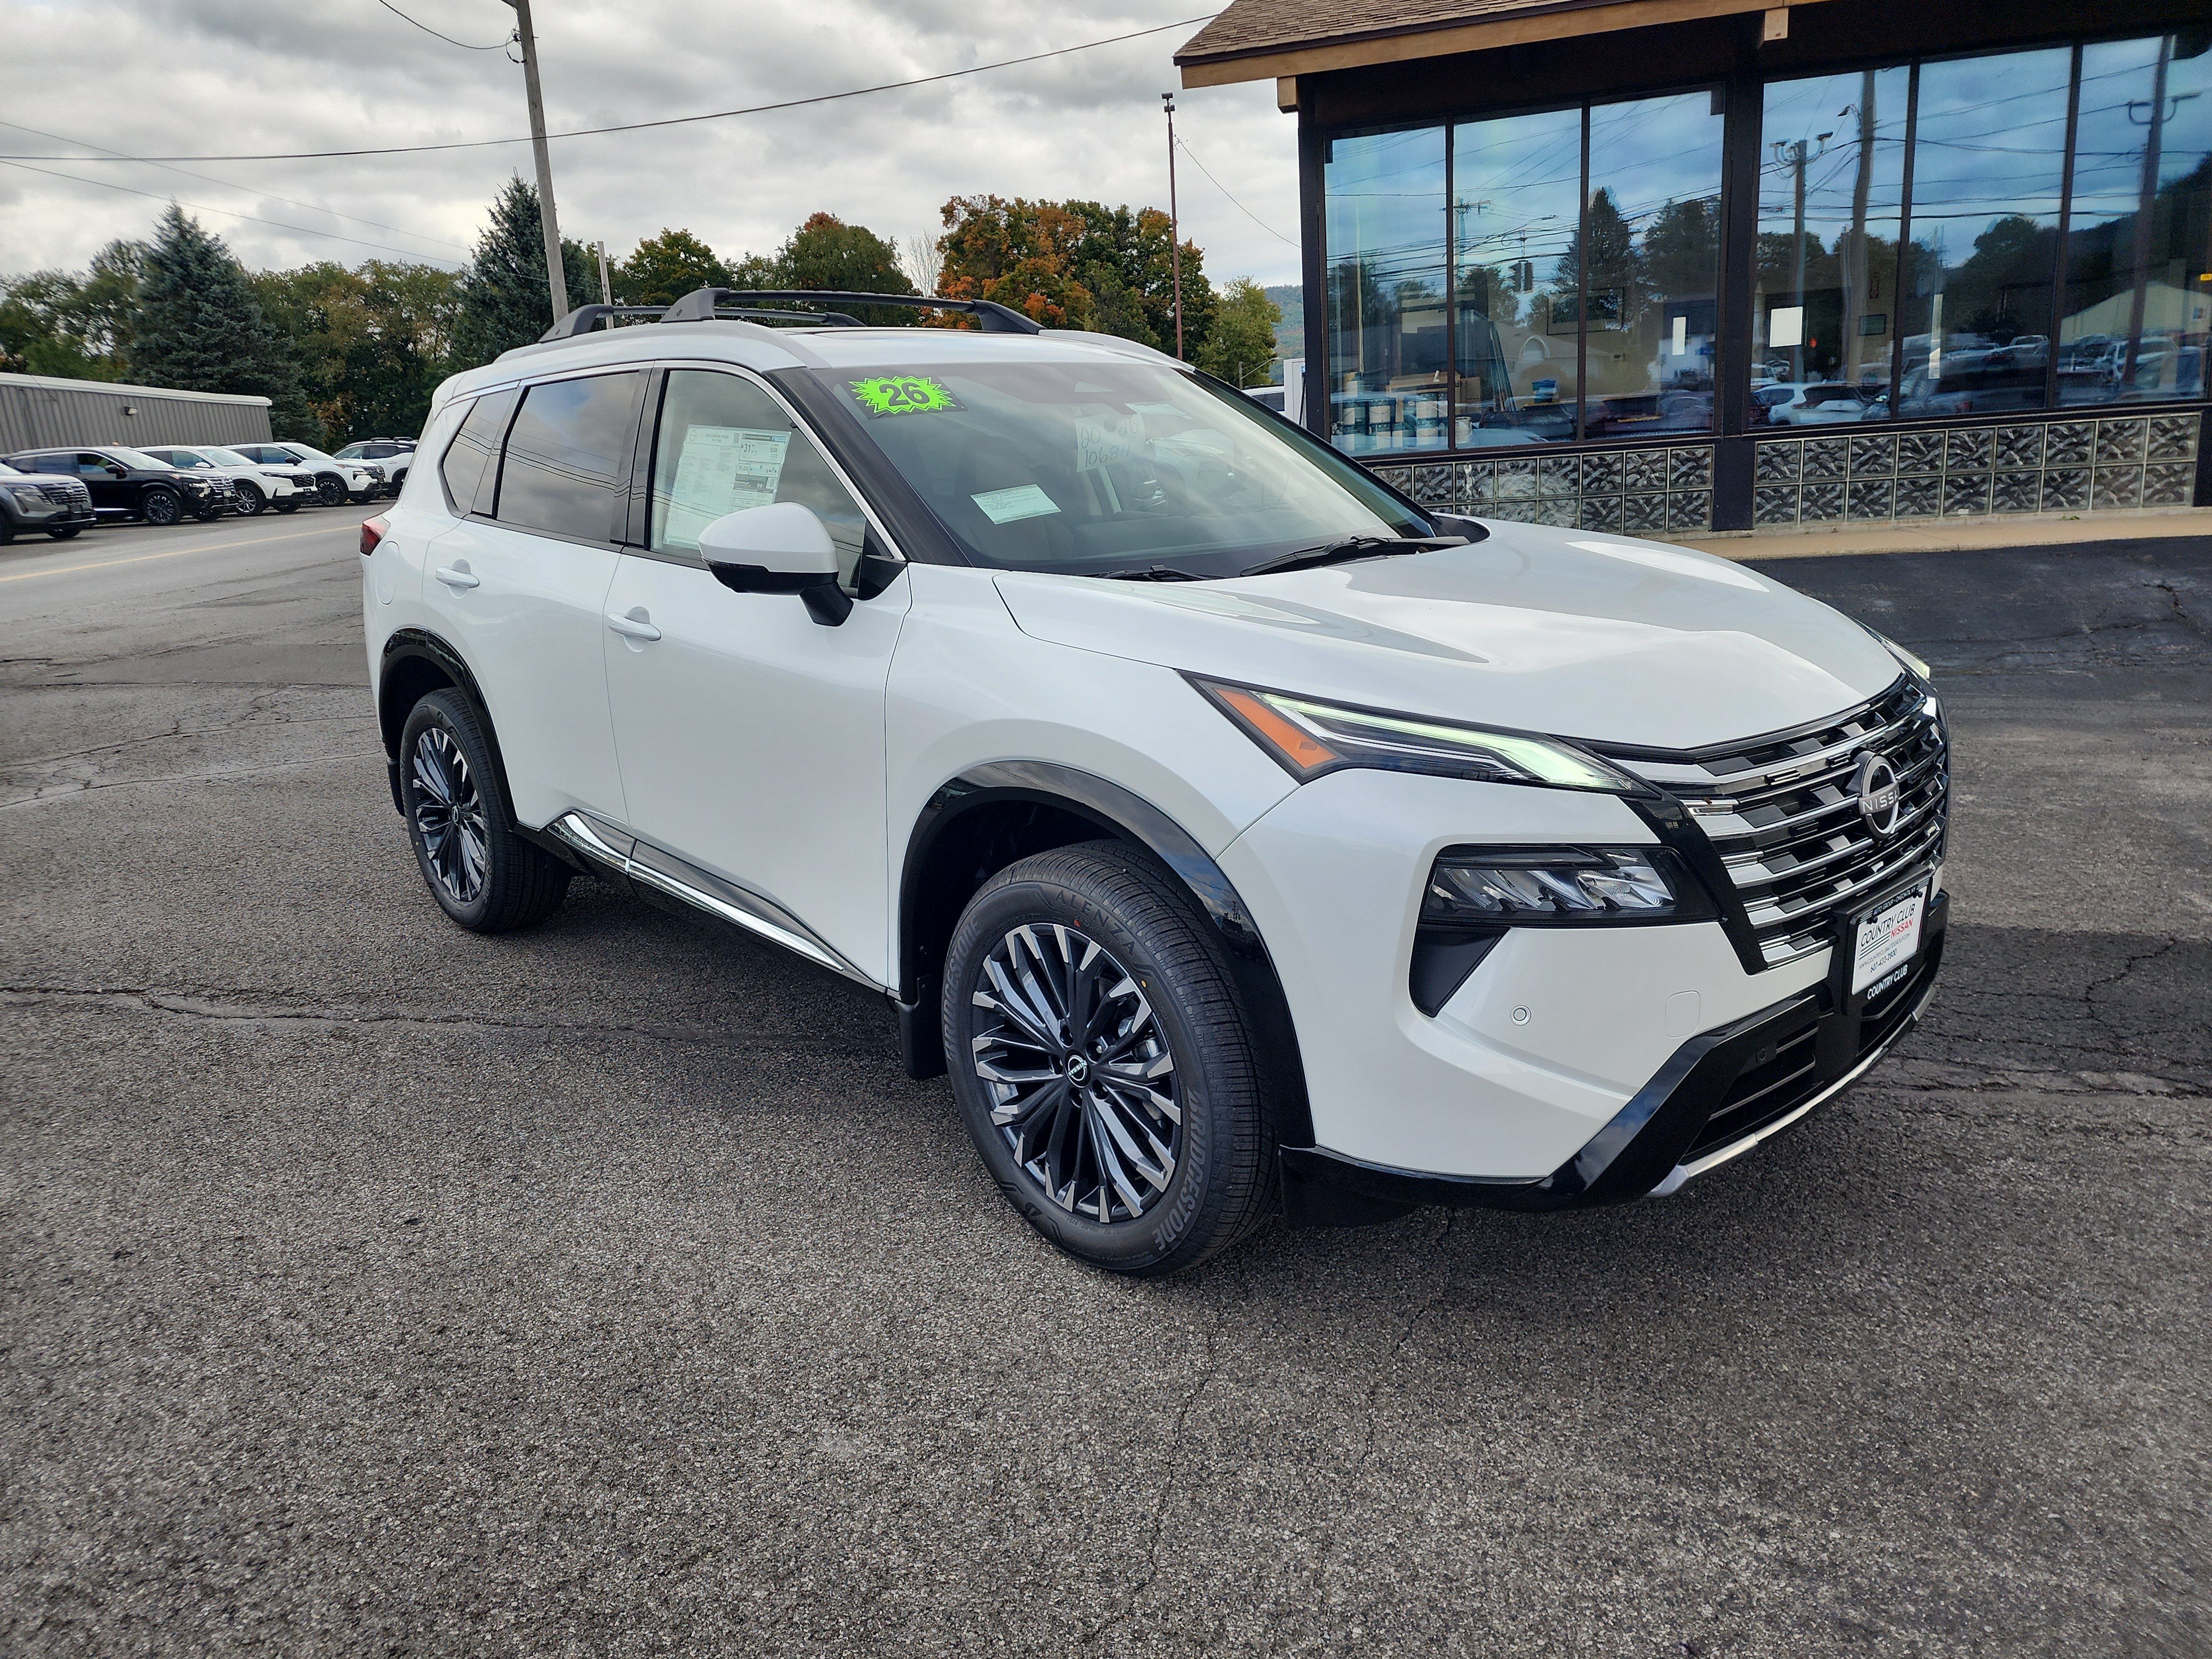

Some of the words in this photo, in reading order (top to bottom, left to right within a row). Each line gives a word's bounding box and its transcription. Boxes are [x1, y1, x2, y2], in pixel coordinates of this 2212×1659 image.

[879, 382, 930, 406] 26
[744, 443, 750, 453] 31
[1081, 426, 1100, 449] 20
[1085, 442, 1131, 467] 106811
[1862, 789, 1900, 812] NISSA
[1055, 889, 1135, 956] ALENZA
[1861, 913, 1897, 947] COUNTRY
[1897, 903, 1916, 924] CLUB
[1891, 918, 1914, 939] NISSAN
[943, 915, 981, 1063] BRIDGESTONE
[1867, 973, 1895, 1000] COUNTRY
[1893, 964, 1908, 982] CLUB
[1152, 1086, 1207, 1251] BRIDGESTONE
